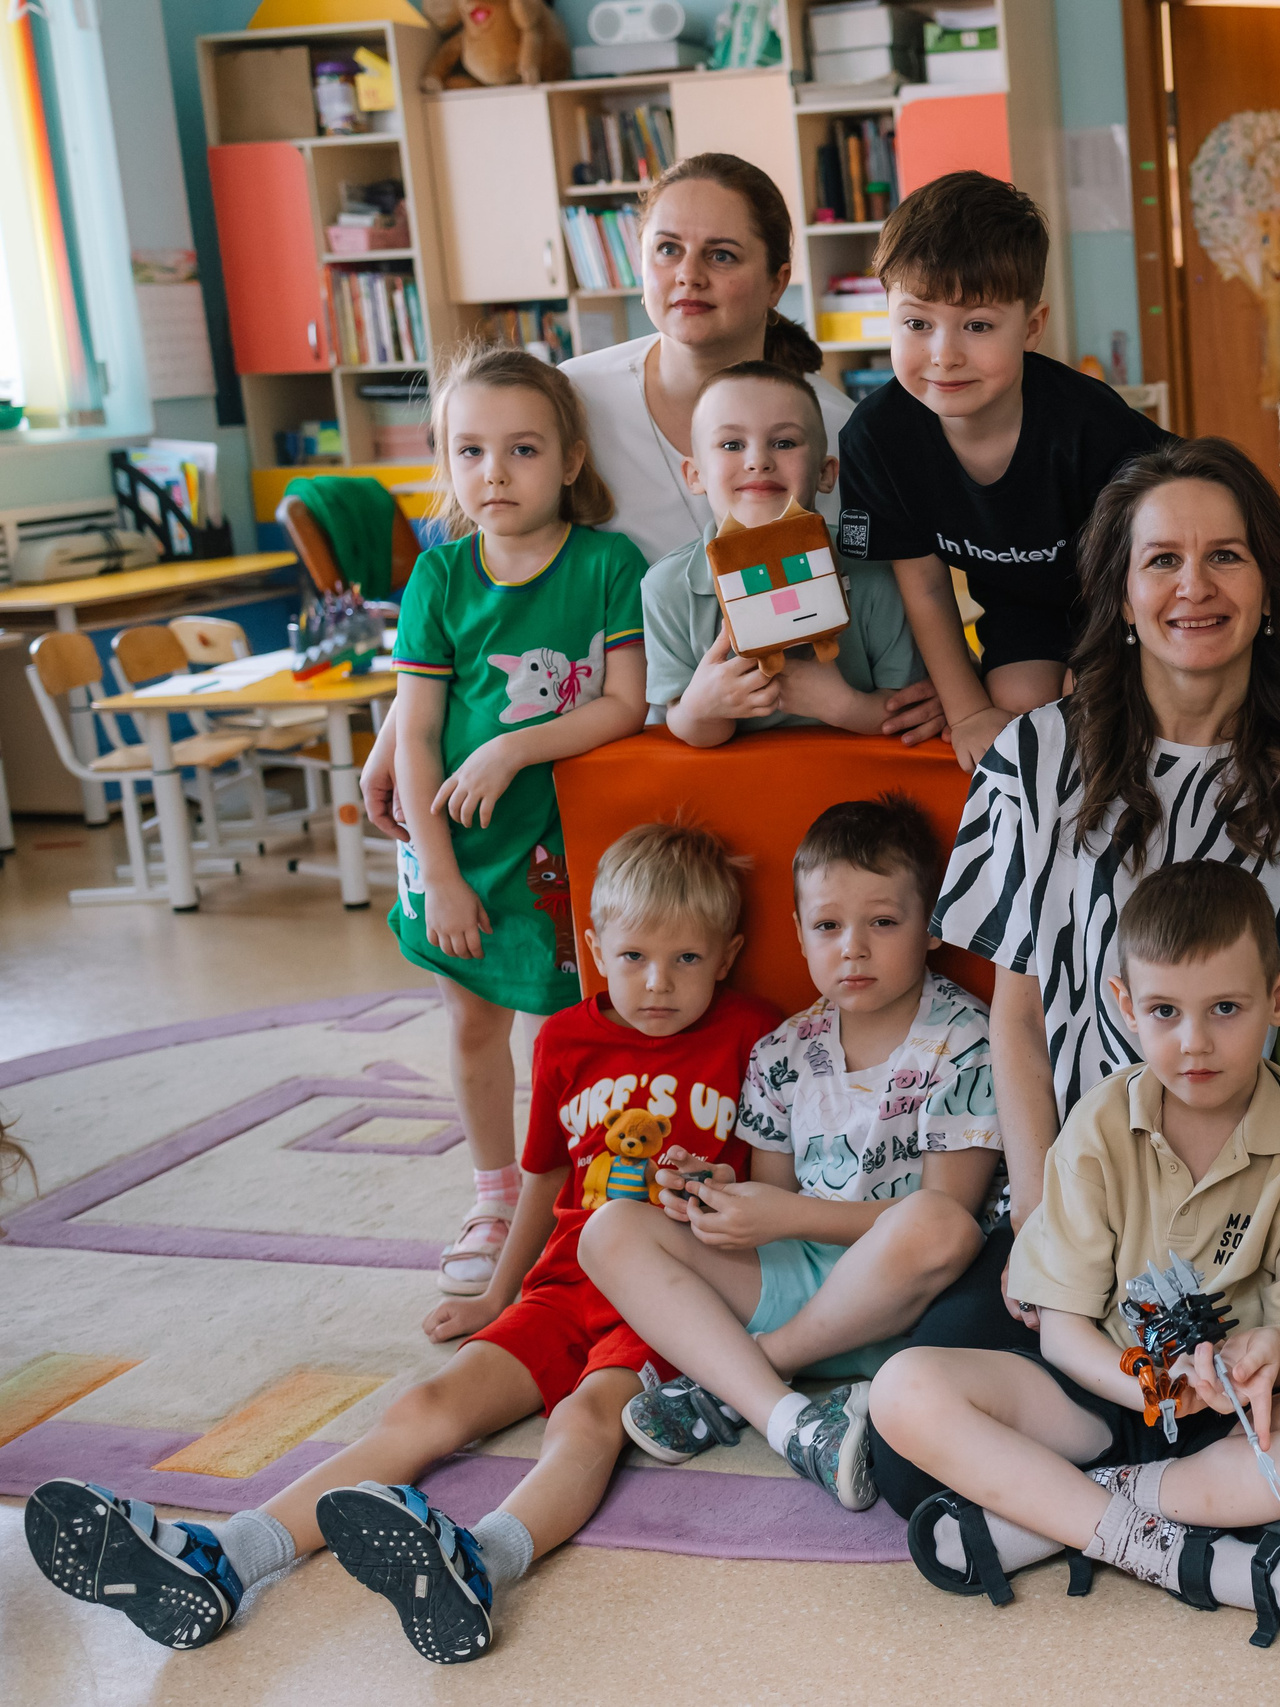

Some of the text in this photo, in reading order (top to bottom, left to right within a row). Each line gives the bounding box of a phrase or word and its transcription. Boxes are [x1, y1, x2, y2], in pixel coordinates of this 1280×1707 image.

[936, 533, 961, 555] in
[559, 1073, 677, 1150] SURF'S
[690, 1082, 737, 1142] UP
[1226, 1213, 1251, 1230] MA
